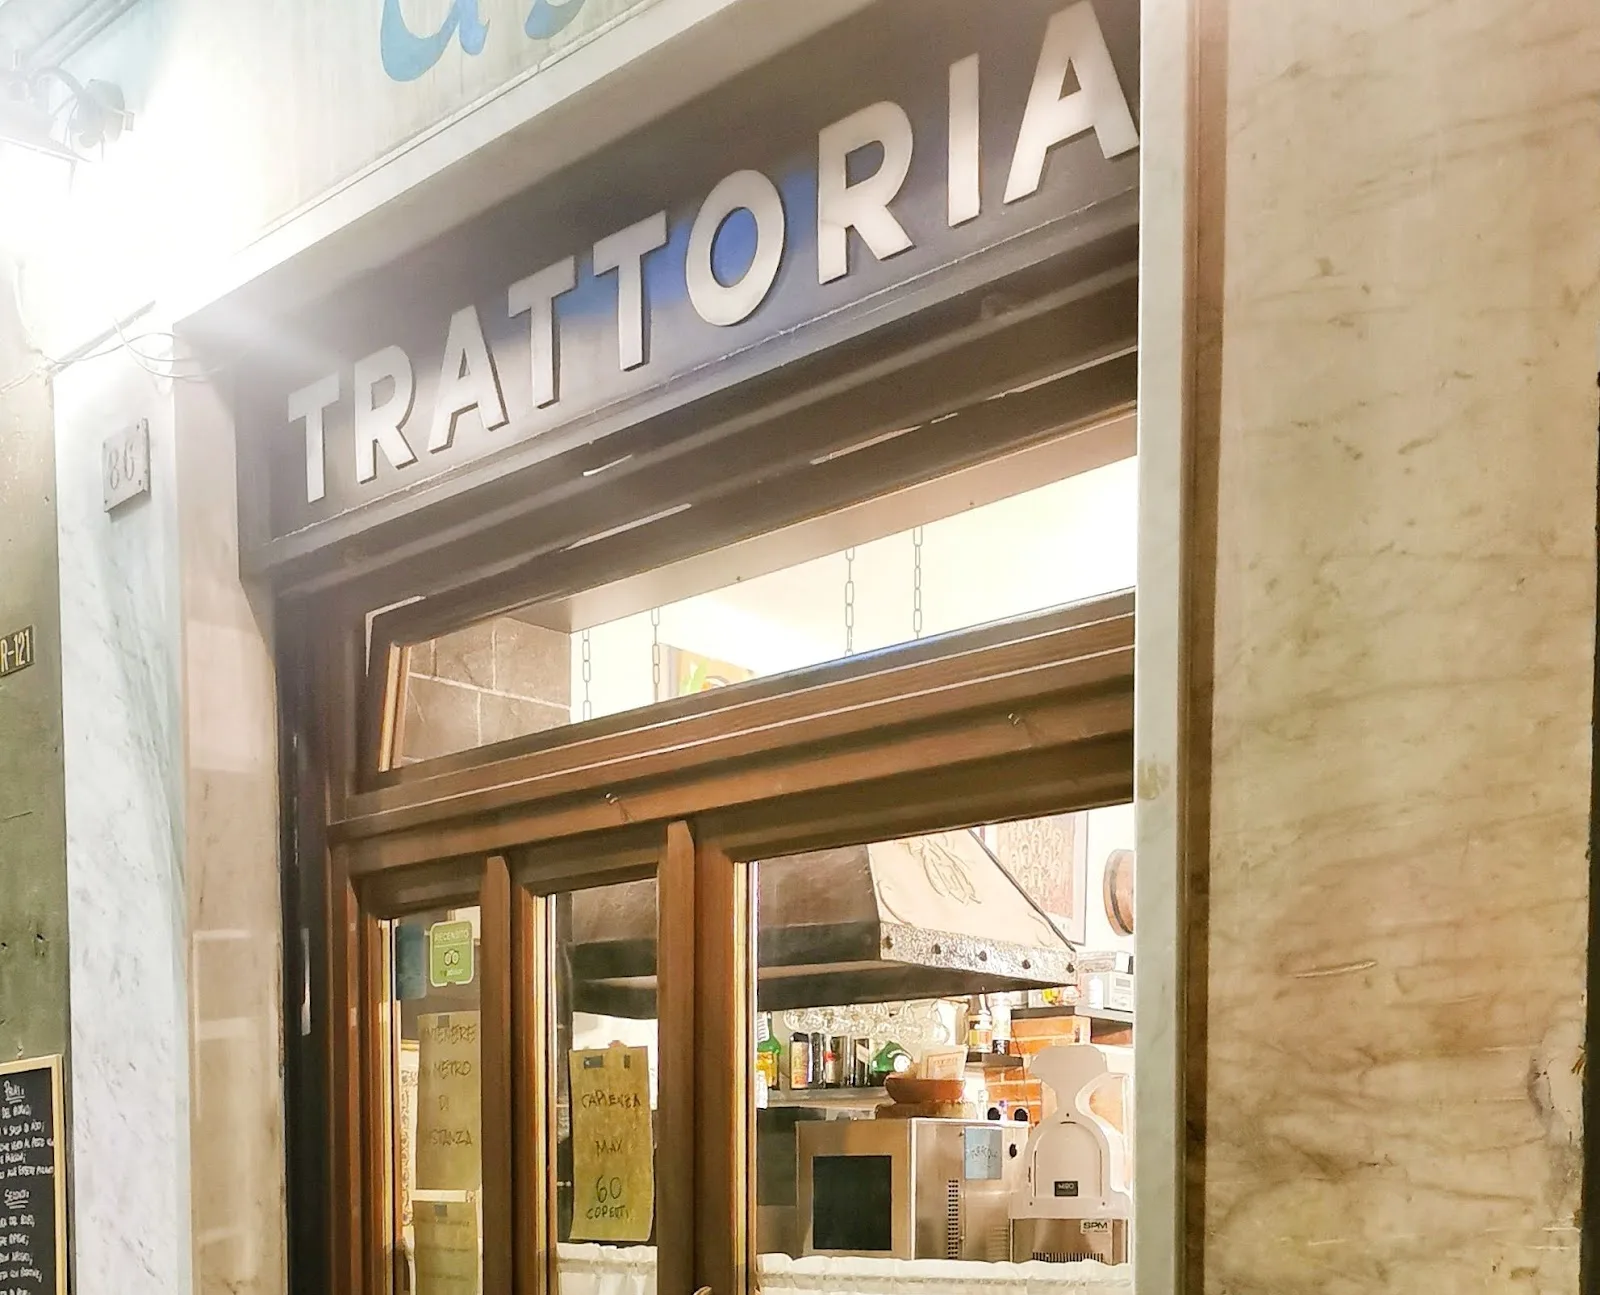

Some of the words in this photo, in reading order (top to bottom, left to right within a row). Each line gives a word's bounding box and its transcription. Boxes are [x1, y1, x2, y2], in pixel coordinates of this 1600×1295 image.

[287, 0, 1141, 504] TRATTORIA
[595, 1139, 624, 1158] MAX
[595, 1175, 623, 1204] 60
[1083, 1221, 1109, 1230] SPM
